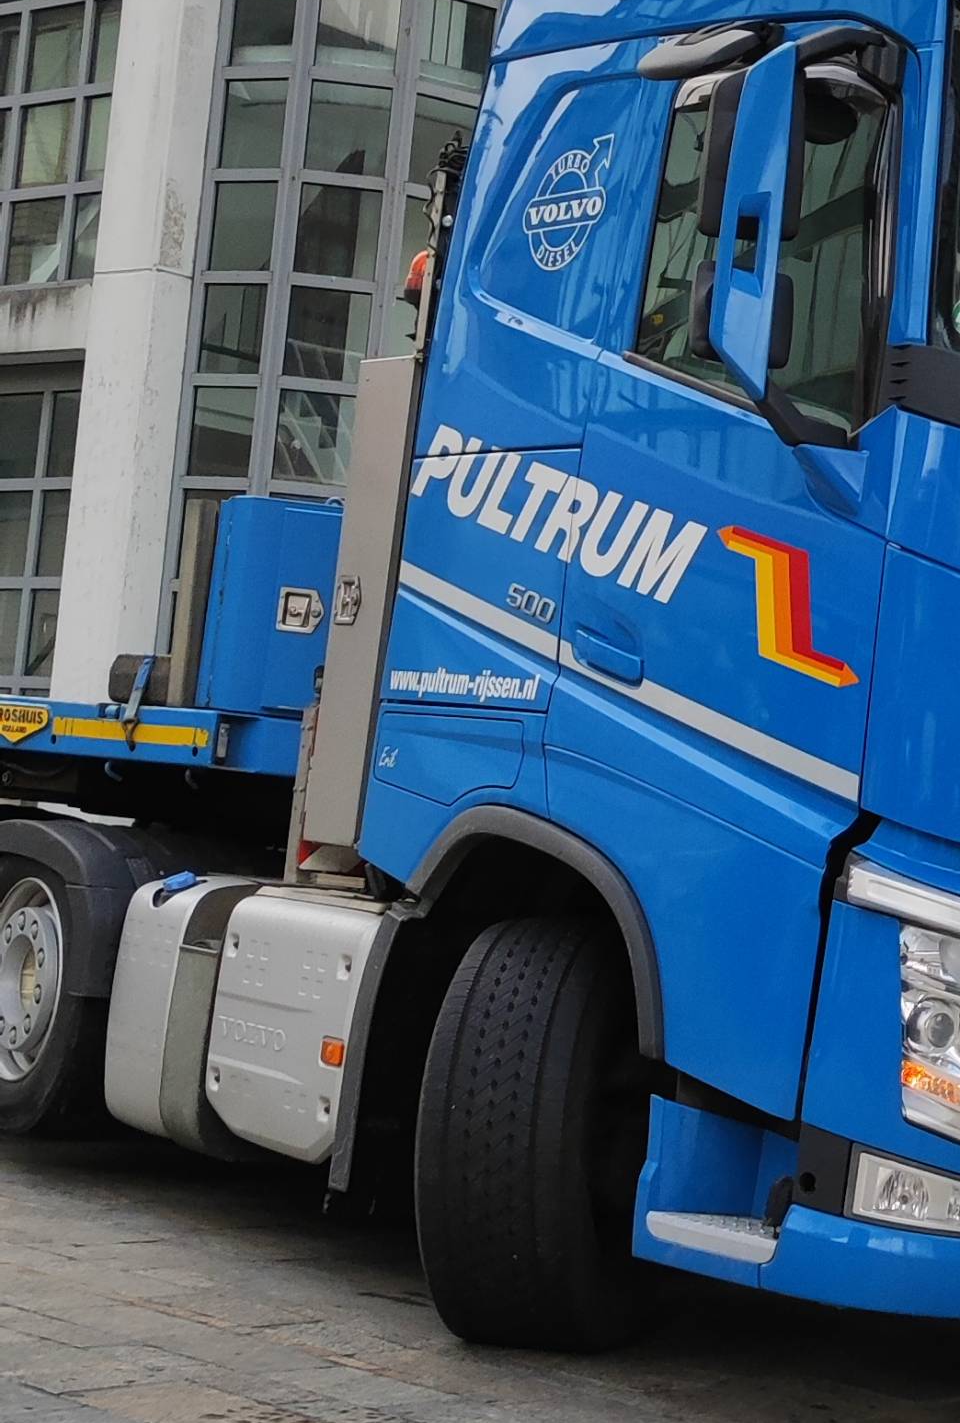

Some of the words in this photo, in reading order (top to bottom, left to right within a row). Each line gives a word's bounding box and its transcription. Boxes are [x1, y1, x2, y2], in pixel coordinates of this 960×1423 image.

[551, 154, 590, 179] TURBO
[528, 196, 602, 225] VOLVO
[536, 240, 579, 267] DIESEL
[410, 423, 709, 604] PULTRUM
[505, 582, 557, 624] 500
[390, 666, 541, 703] www.pultrum-rijssen.nl
[217, 1015, 287, 1051] VOLVO
